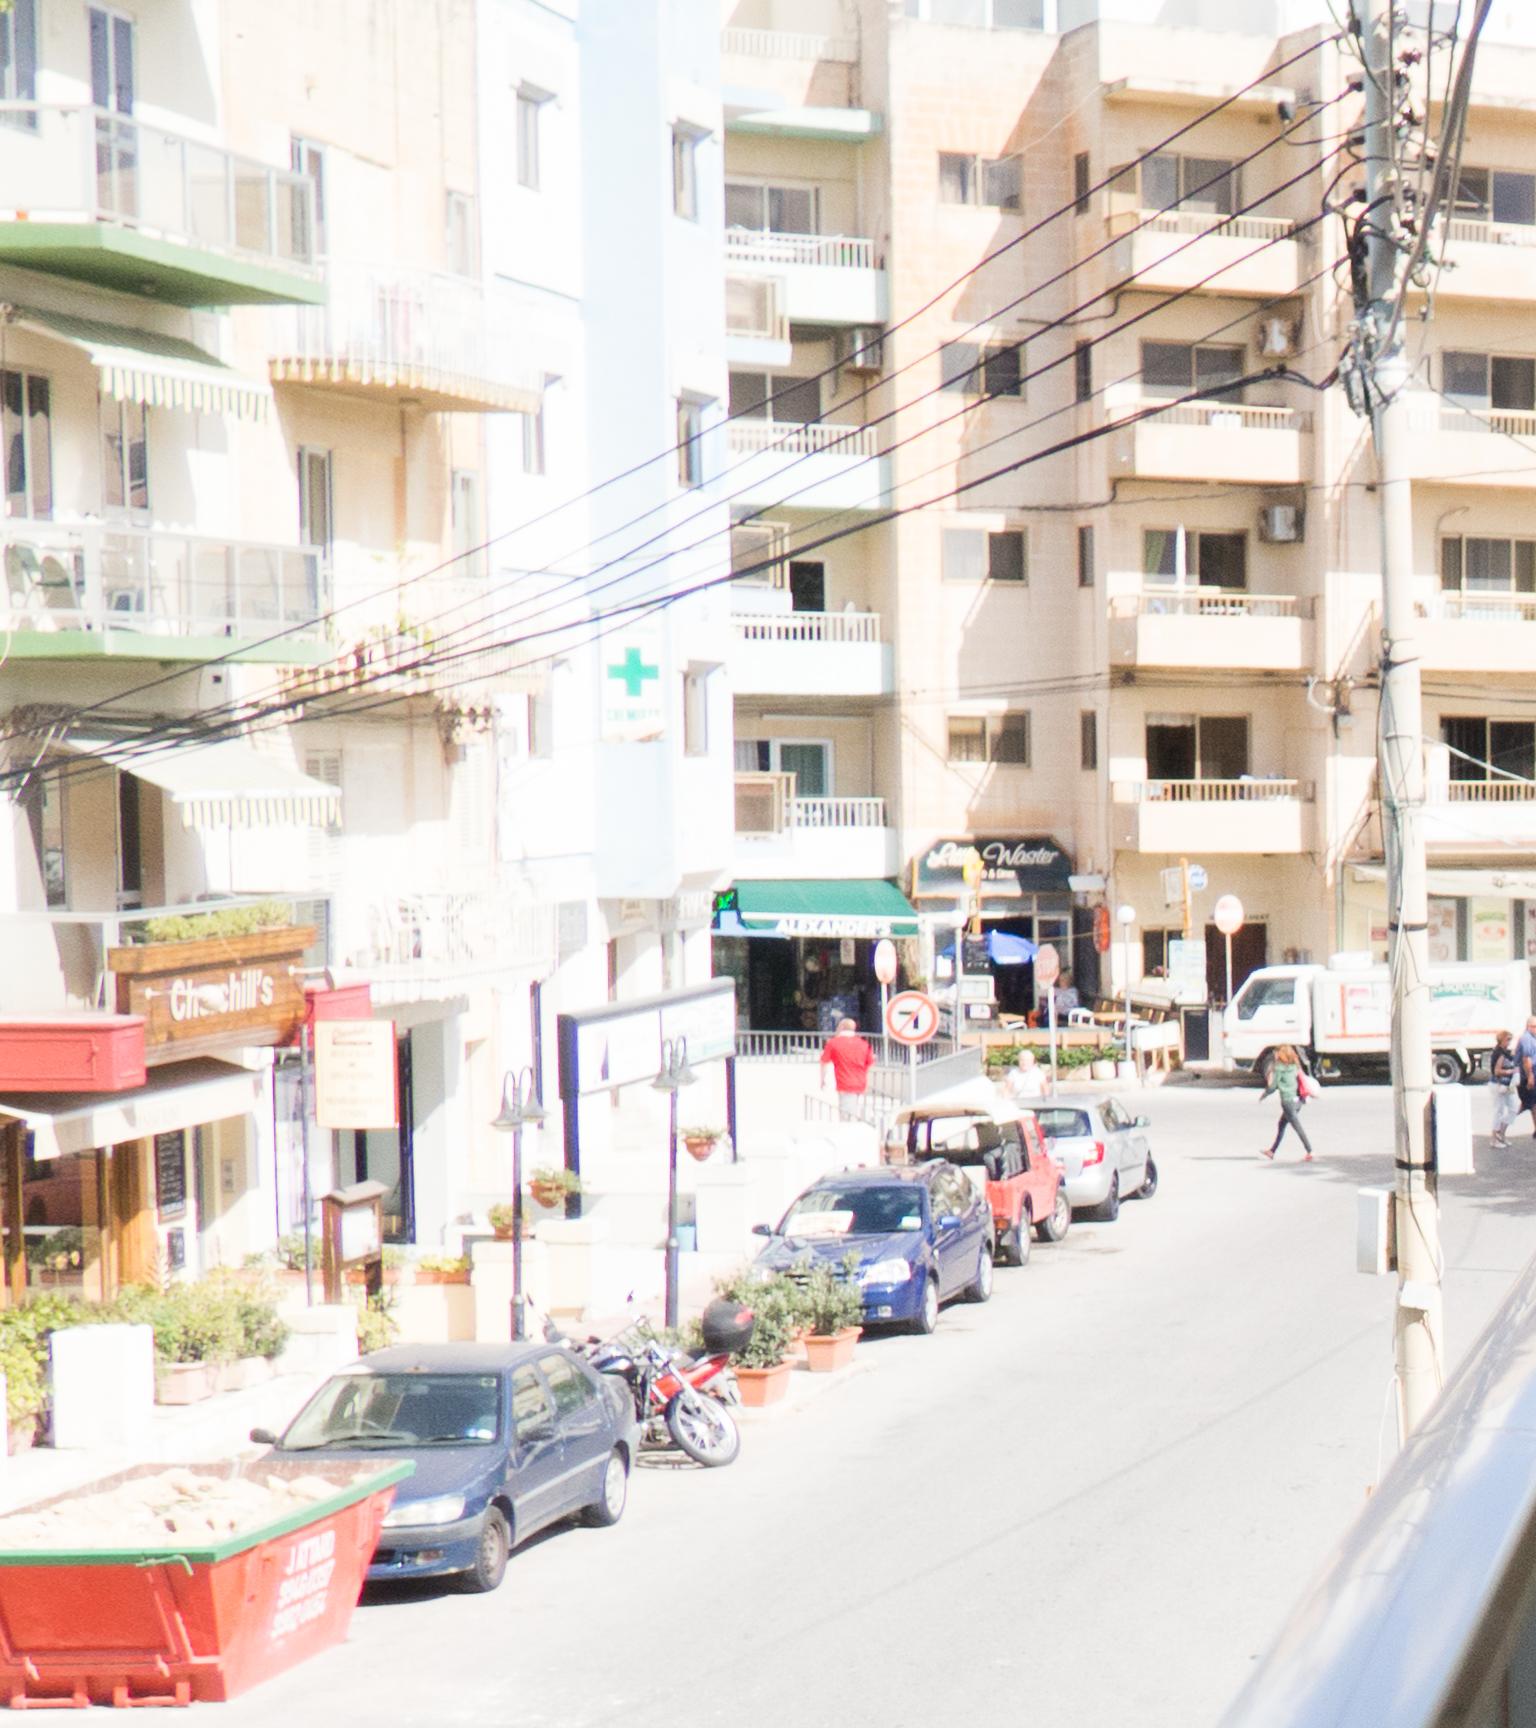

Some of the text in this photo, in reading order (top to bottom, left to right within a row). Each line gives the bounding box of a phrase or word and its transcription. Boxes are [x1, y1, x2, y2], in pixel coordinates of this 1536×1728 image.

[983, 842, 1059, 867] Waster
[775, 919, 891, 936] ALEXANDER'S
[170, 968, 274, 1021] Chchill's
